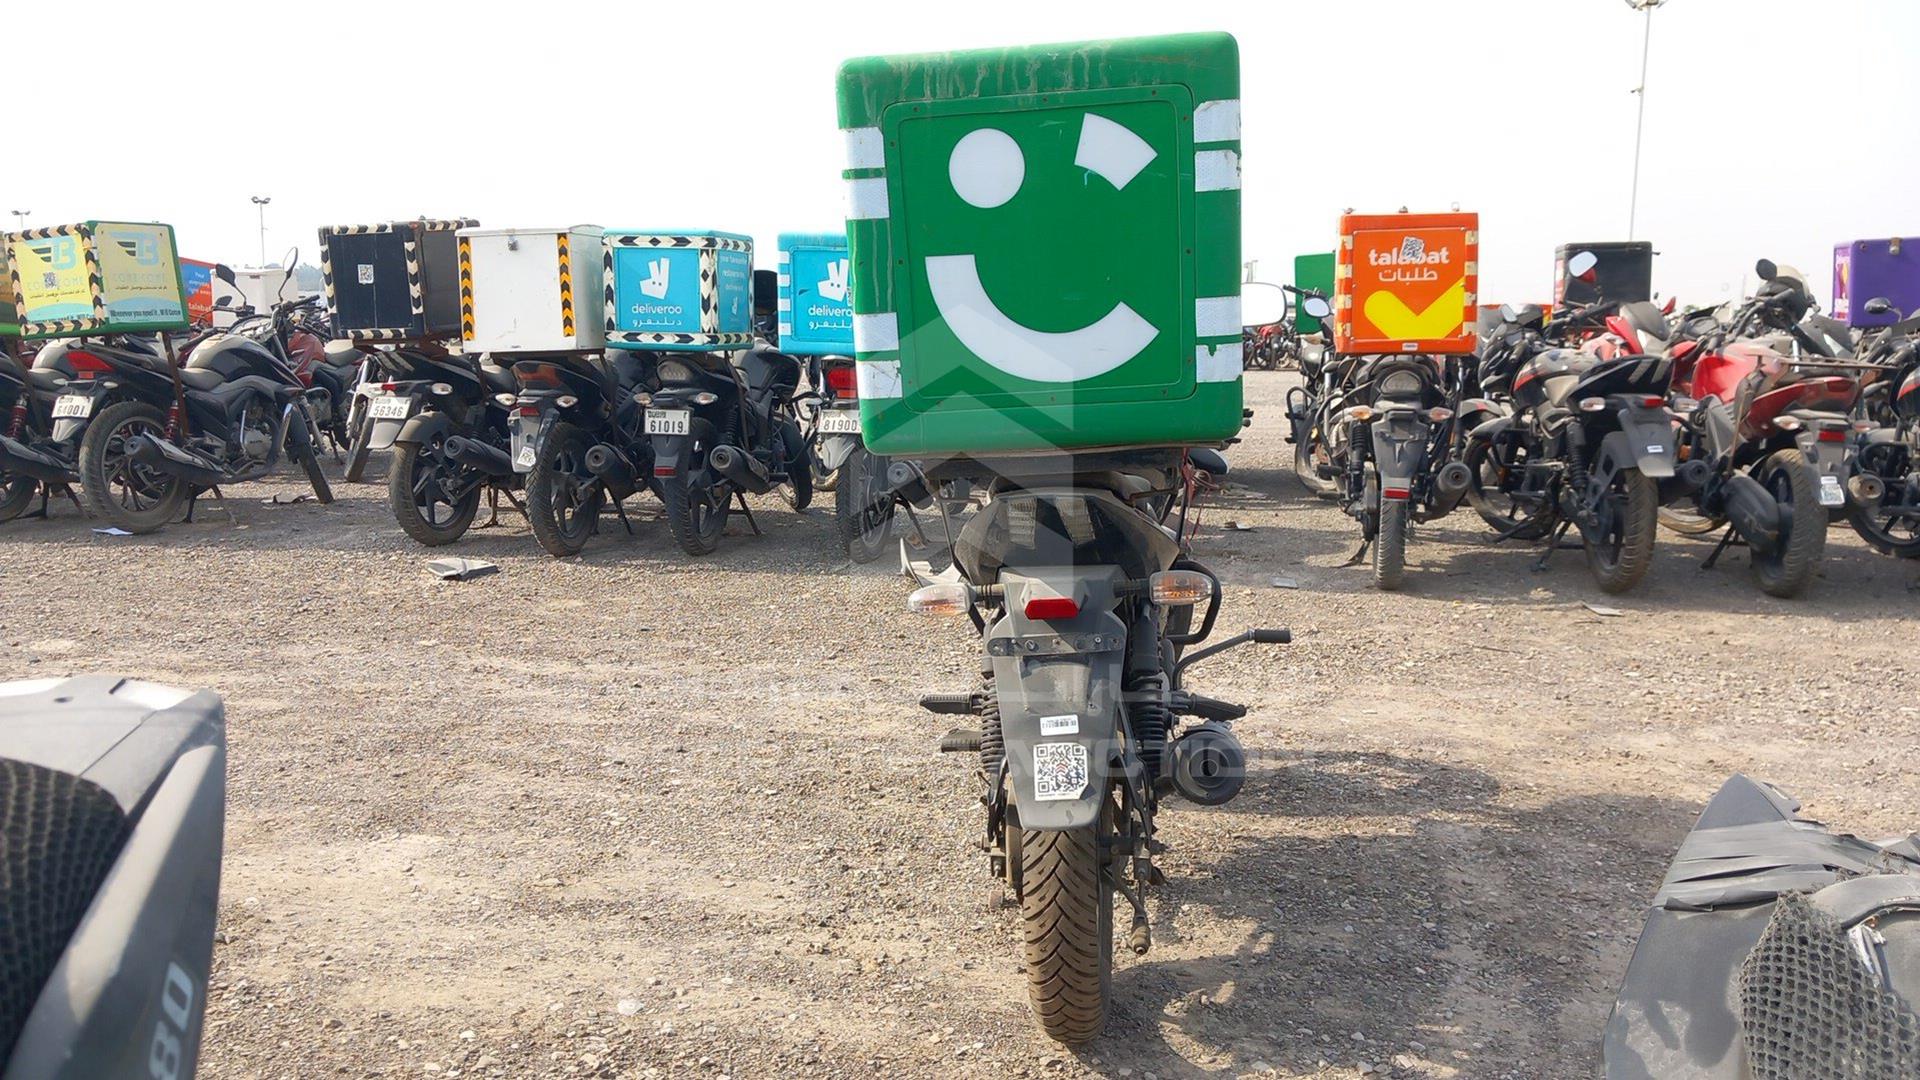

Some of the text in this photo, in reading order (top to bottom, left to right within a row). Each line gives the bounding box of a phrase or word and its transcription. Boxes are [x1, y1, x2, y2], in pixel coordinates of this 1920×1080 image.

[1378, 267, 1438, 285] طلبات
[631, 303, 682, 314] deliveroo
[808, 304, 853, 317] delivero
[373, 405, 403, 417] 56346
[650, 420, 683, 433] 61019
[823, 419, 857, 431] 81900
